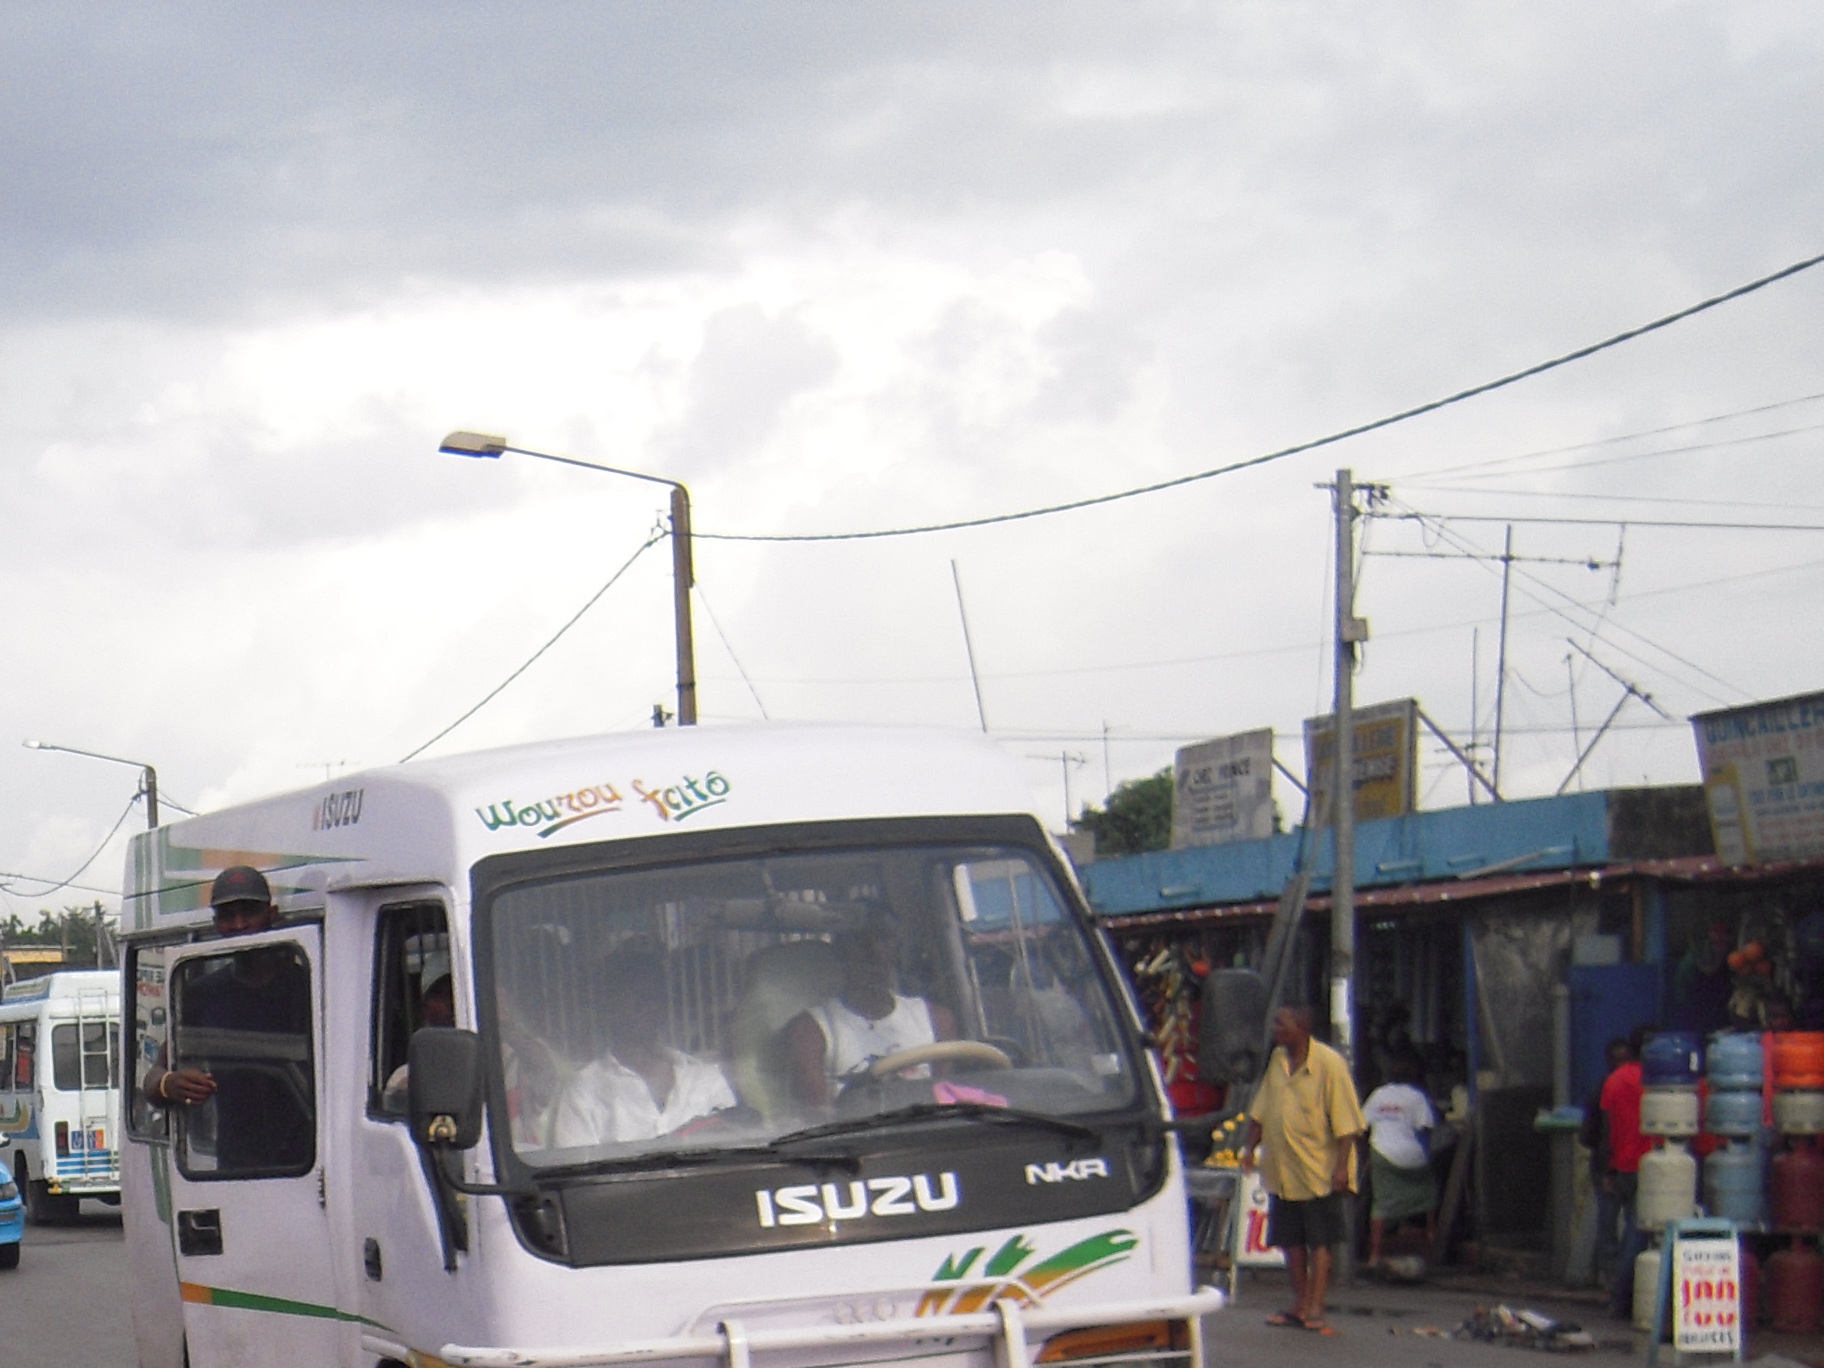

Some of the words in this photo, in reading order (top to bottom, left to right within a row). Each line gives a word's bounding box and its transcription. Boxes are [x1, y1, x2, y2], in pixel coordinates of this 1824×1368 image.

[320, 788, 365, 831] ISUZU
[1024, 1158, 1110, 1186] NKR
[755, 1171, 960, 1229] ISUZU
